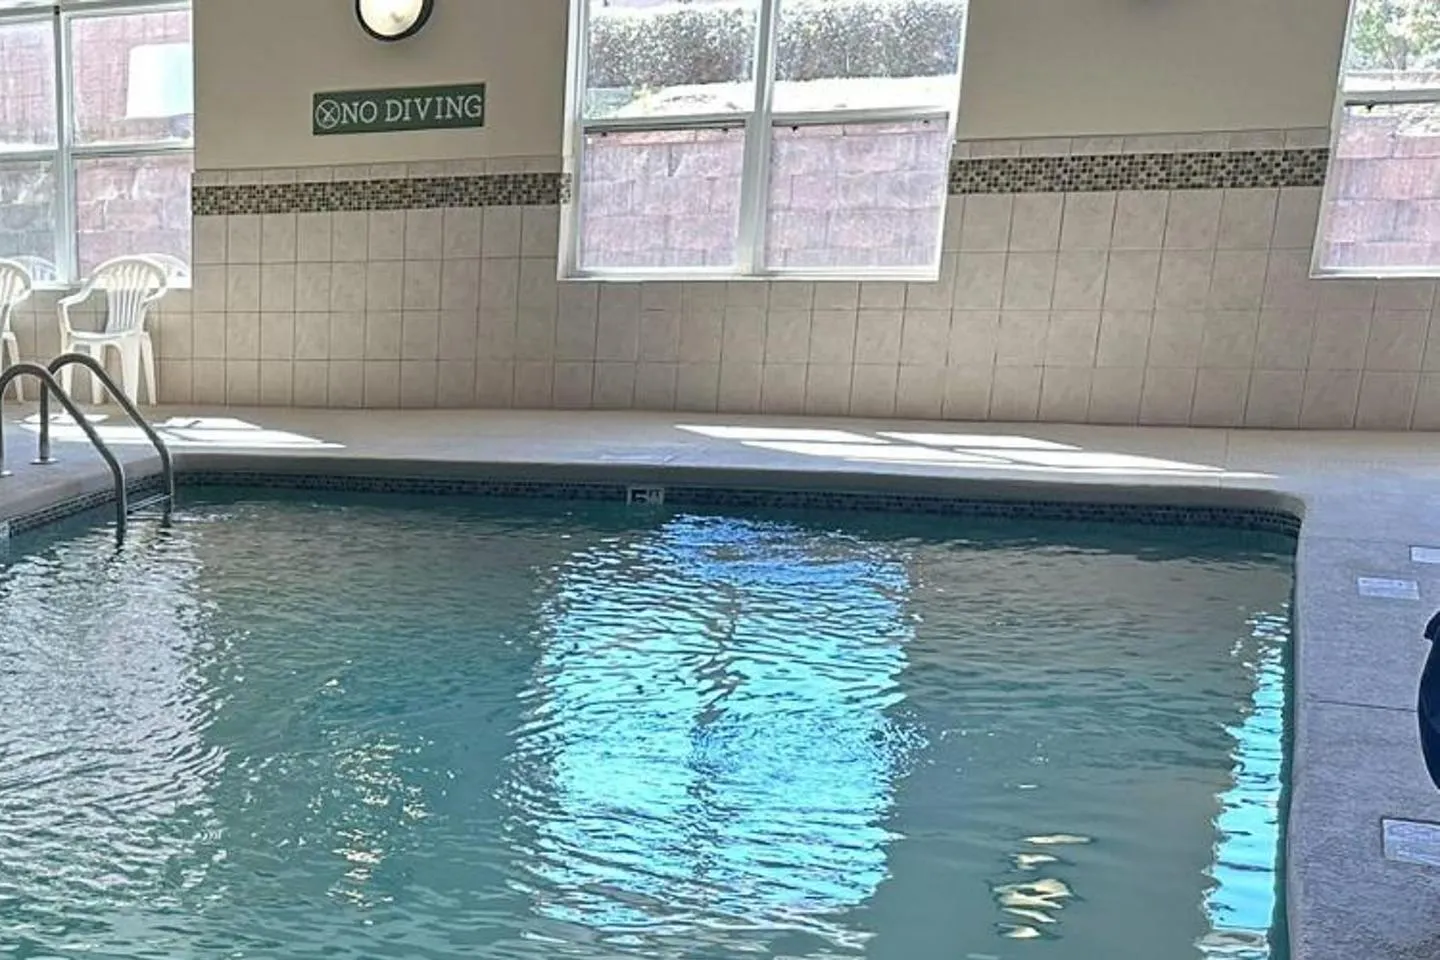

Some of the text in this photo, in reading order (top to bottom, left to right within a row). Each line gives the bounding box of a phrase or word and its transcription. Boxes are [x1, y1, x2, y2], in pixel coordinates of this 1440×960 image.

[341, 94, 482, 124] NO DIVING
[631, 488, 648, 503] 5
